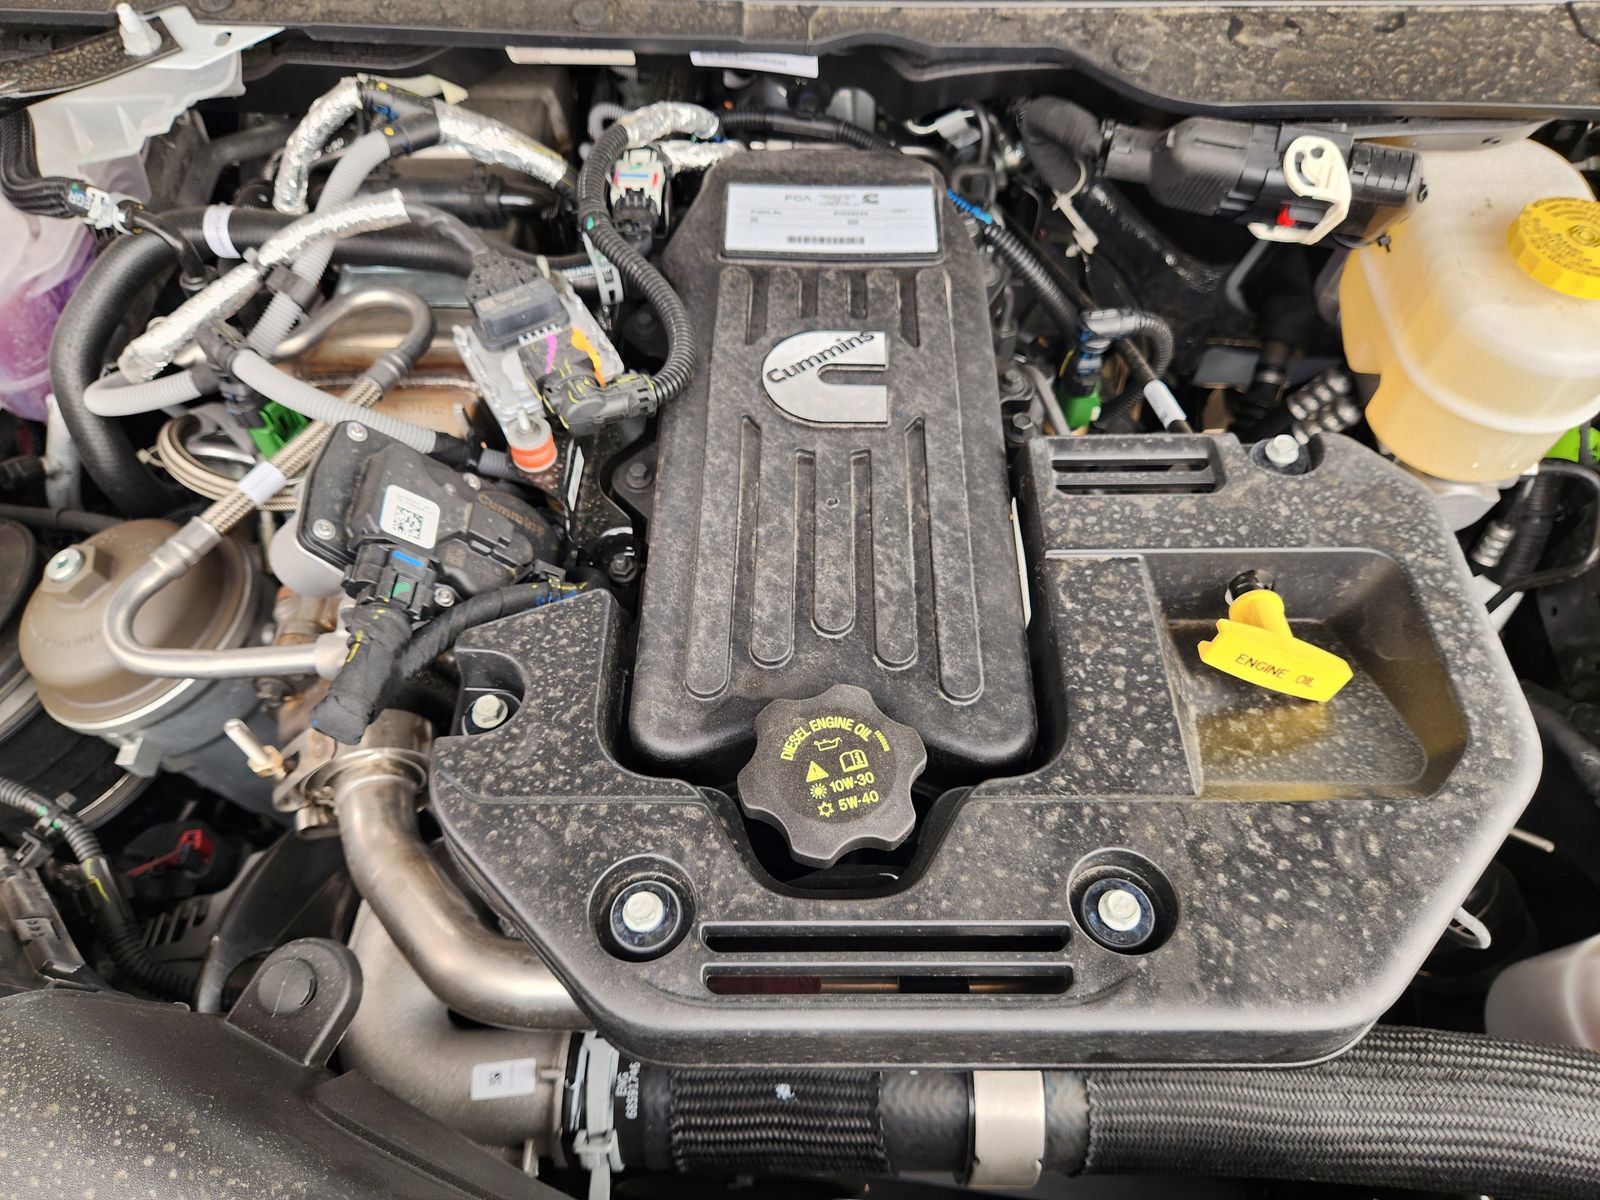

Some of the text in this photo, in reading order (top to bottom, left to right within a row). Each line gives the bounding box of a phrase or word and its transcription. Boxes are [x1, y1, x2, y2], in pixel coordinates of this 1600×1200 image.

[766, 331, 875, 383] Cummins
[1235, 653, 1315, 688] ENGINE OIL
[780, 726, 812, 761] DIESEL
[808, 716, 854, 733] ENGINE
[854, 723, 872, 742] OIL
[829, 771, 875, 793] 10W-30
[838, 790, 880, 811] 5W-40
